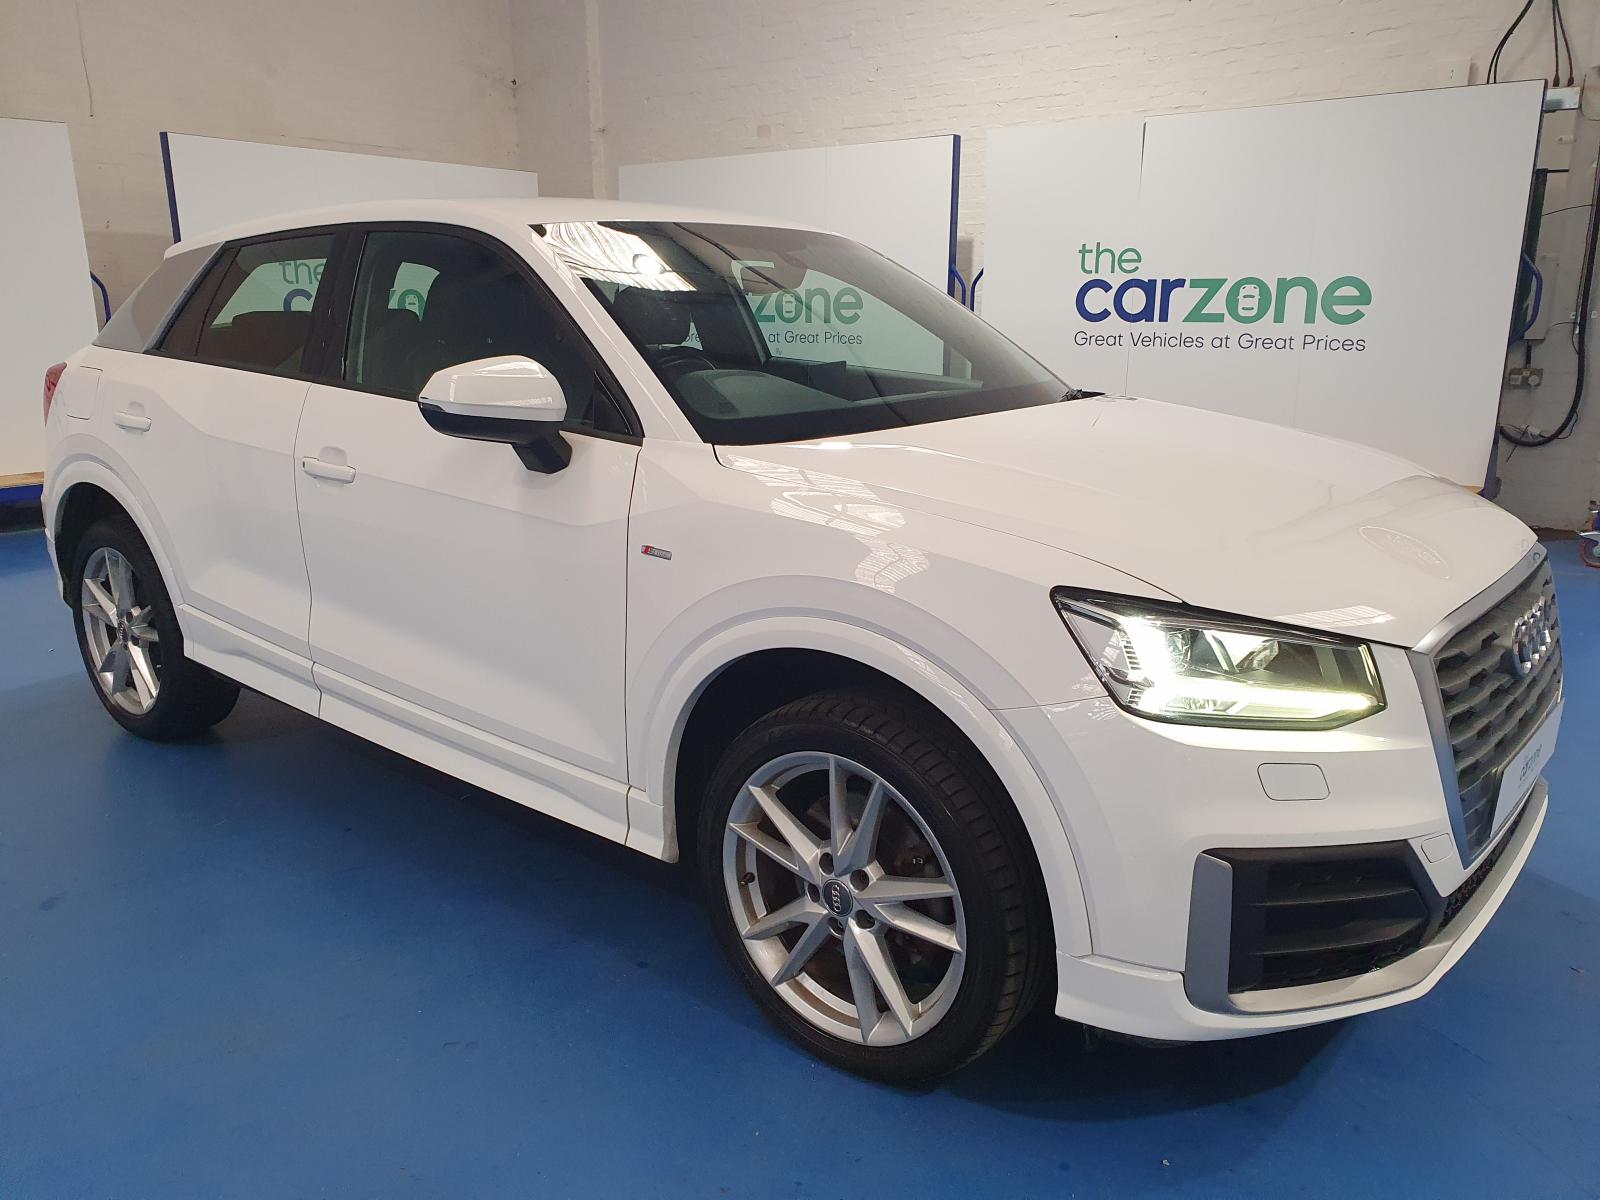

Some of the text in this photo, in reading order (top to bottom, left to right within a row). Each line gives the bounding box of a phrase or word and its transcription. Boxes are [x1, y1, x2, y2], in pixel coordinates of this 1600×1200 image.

[1078, 241, 1142, 274] the
[749, 286, 864, 325] zone
[1075, 275, 1373, 325] carzone
[768, 330, 863, 345] at Great Prices
[1073, 330, 1367, 352] Great Vehicles at Great Prices
